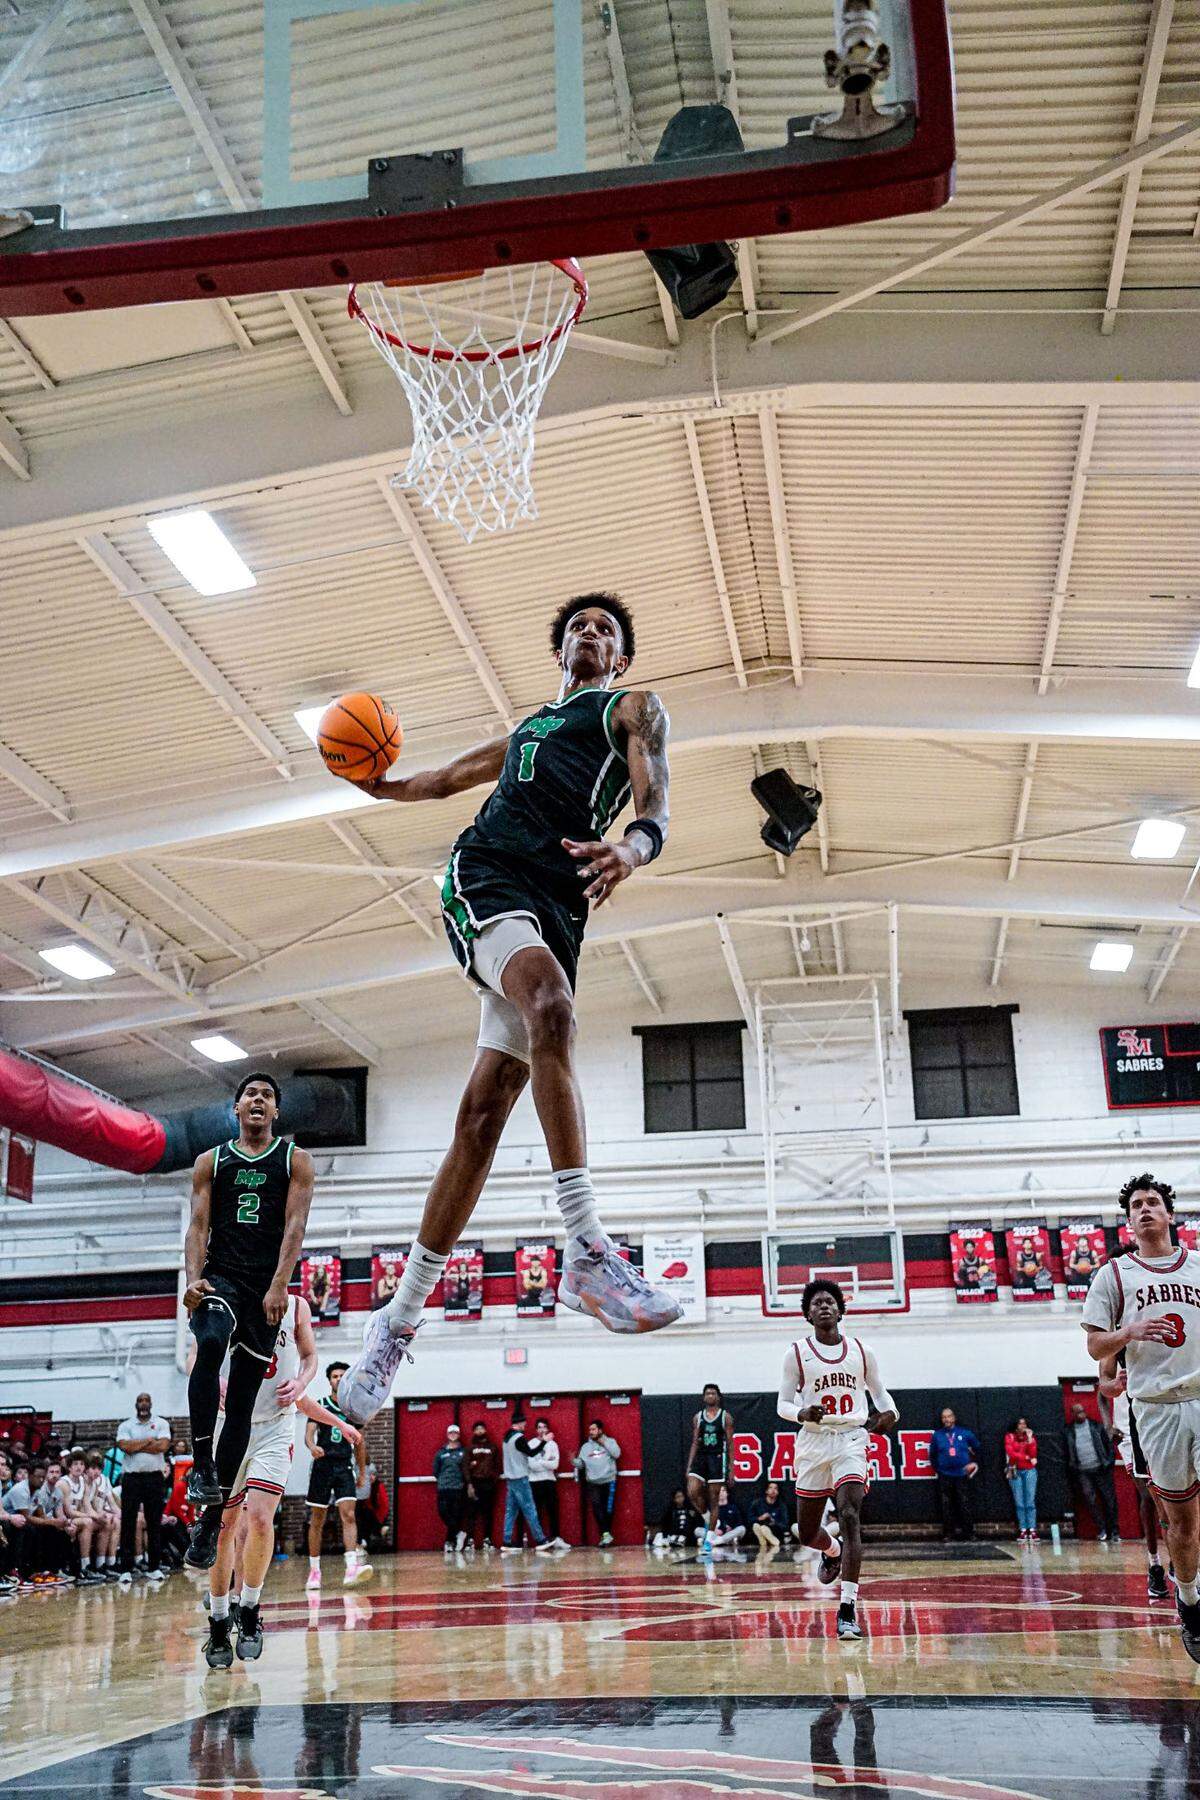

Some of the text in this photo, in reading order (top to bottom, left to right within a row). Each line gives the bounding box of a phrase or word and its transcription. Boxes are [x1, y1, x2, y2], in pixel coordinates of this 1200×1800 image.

[518, 742, 540, 781] 1
[1116, 1058, 1165, 1073] SABRES
[237, 1193, 260, 1224] 2
[1136, 1282, 1200, 1312] SABRES
[1160, 1313, 1187, 1349] 3
[814, 1371, 858, 1393] SABRES
[821, 1393, 854, 1416] 30
[330, 1425, 342, 1443] 5
[732, 1431, 938, 1482] SARE
